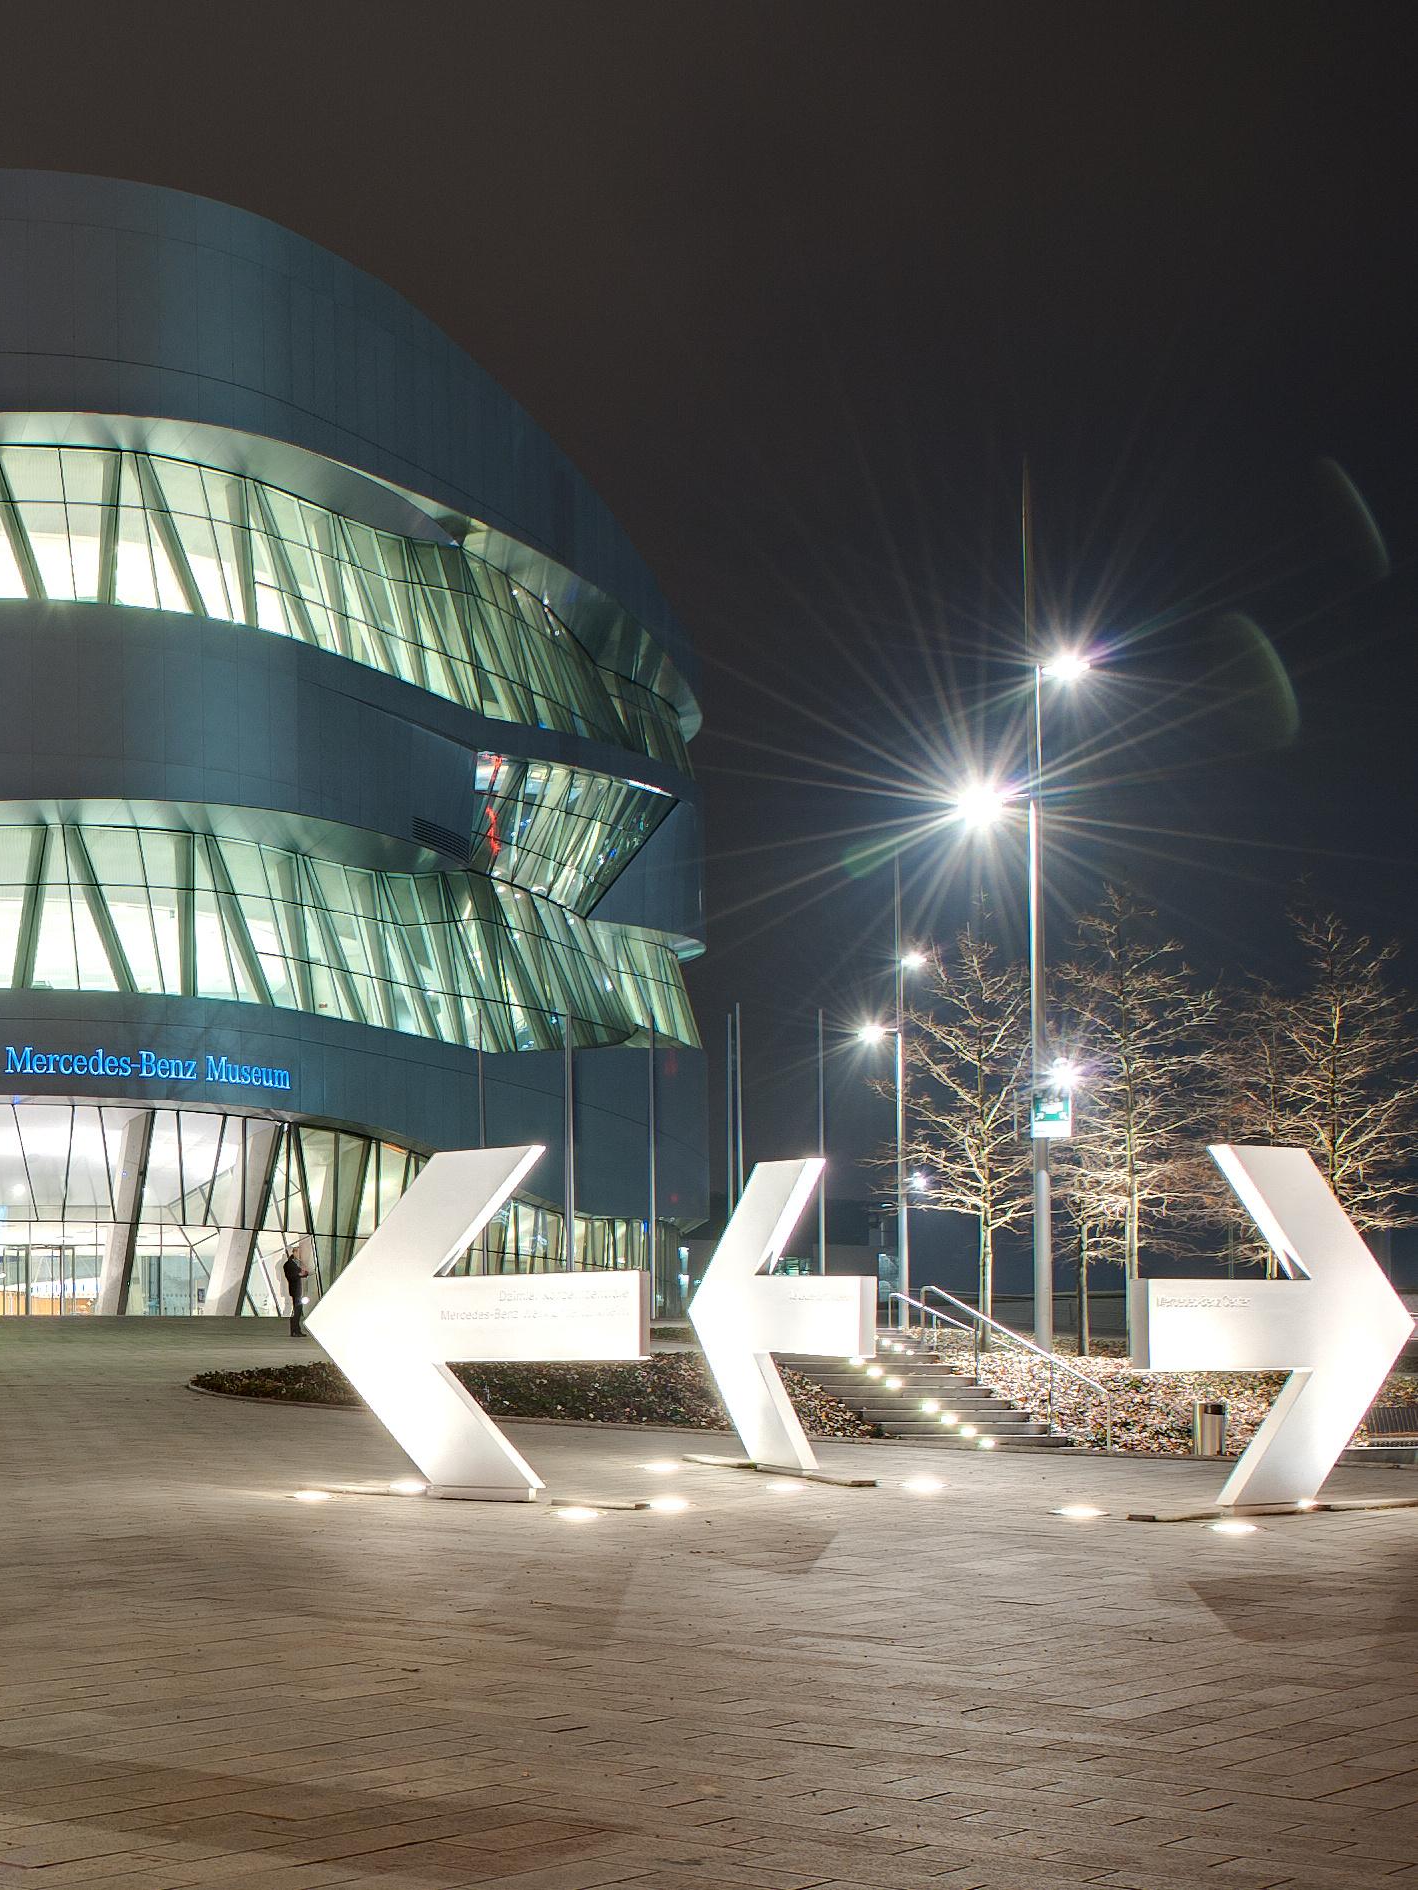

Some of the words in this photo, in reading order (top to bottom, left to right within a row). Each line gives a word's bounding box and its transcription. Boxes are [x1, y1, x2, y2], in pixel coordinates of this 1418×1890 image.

[5, 1046, 197, 1080] Mercedes-Benz
[205, 1055, 292, 1090] Museum
[440, 1308, 519, 1321] Mercedes-Benz
